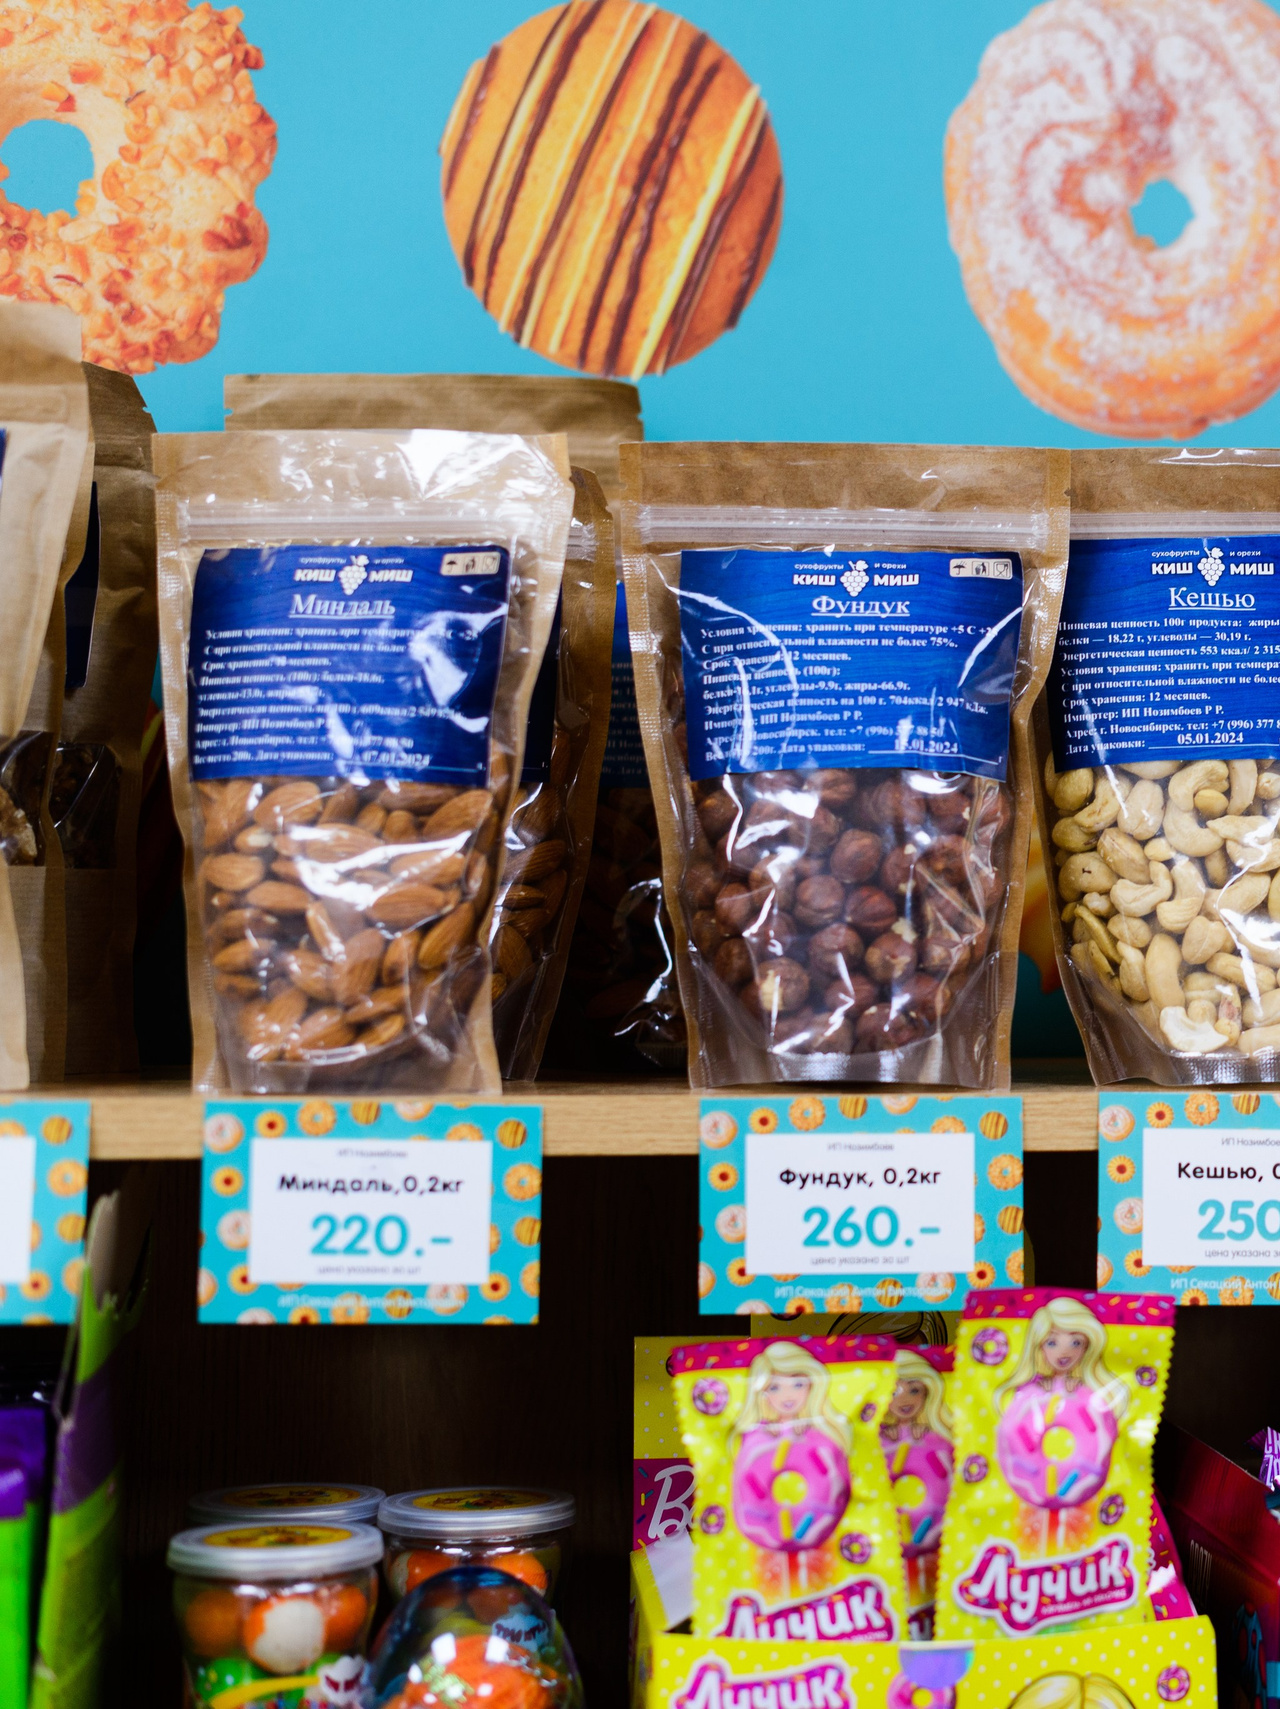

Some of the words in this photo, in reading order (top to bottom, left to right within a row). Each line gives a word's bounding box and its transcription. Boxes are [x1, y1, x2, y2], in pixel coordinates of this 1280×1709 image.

[1152, 550, 1200, 558] сухофрукты
[1237, 550, 1261, 558] орехи
[794, 563, 844, 571] сухофрукты
[882, 562, 906, 570] орехи
[1152, 563, 1193, 575] КИШ
[1230, 563, 1274, 575] МИШ
[294, 569, 336, 581] КИШ
[369, 570, 413, 583] МИШ
[793, 574, 836, 585] КИШ
[874, 574, 919, 586] МИШ
[292, 594, 395, 617] Миндаль
[1168, 586, 1256, 608] Кешью
[811, 595, 910, 617] Фундук
[1111, 620, 1160, 629] ценность
[1164, 618, 1186, 627] 100г
[1189, 618, 1242, 630] продукта:
[1249, 619, 1279, 627] жиры
[1059, 637, 1089, 646] белки
[1108, 634, 1134, 644] 18,22
[1147, 633, 1197, 644] углеводы
[1215, 632, 1241, 641] 30,19
[1062, 651, 1145, 662] Энергетическая
[1148, 648, 1197, 658] ценность
[1200, 646, 1217, 654] 553
[1221, 646, 1250, 655] ккал/
[1061, 666, 1103, 677] Условия
[1107, 664, 1161, 676] хранения:
[1165, 662, 1209, 673] хранить
[1212, 662, 1232, 671] при
[1072, 681, 1091, 692] при
[1094, 677, 1174, 689] относительной
[1178, 675, 1236, 687] влажности
[1239, 676, 1251, 684] не
[1063, 698, 1089, 709] Срок
[1092, 695, 1145, 707] хранения:
[1150, 692, 1161, 701] 12
[1164, 692, 1210, 701] месяцев.
[1064, 711, 1118, 723] Импортер:
[1122, 708, 1139, 718] ИП
[1144, 706, 1202, 717] Нозимбоев
[1066, 728, 1097, 739] Адрес:
[1110, 723, 1183, 734] Новосибирск.
[1212, 720, 1224, 729] +7
[1228, 719, 1253, 730] (996)
[1256, 719, 1274, 729] 377
[1066, 744, 1088, 755] Дата
[1091, 740, 1145, 754] упаковки:
[1177, 732, 1243, 744] 05.01.2024
[1221, 1138, 1234, 1146] ИП
[779, 1168, 874, 1190] Фундук,
[883, 1168, 941, 1187] 0,2кг
[1178, 1163, 1263, 1183] Кешью,
[310, 1213, 452, 1257] 220.-
[802, 1205, 940, 1248] 260.-
[1205, 1250, 1229, 1259] цена
[1231, 1248, 1275, 1260] указана
[1171, 1279, 1187, 1289] ИП
[1190, 1277, 1242, 1291] Секацкий
[1245, 1278, 1276, 1289] Антон
[969, 1545, 1126, 1624] Лучик
